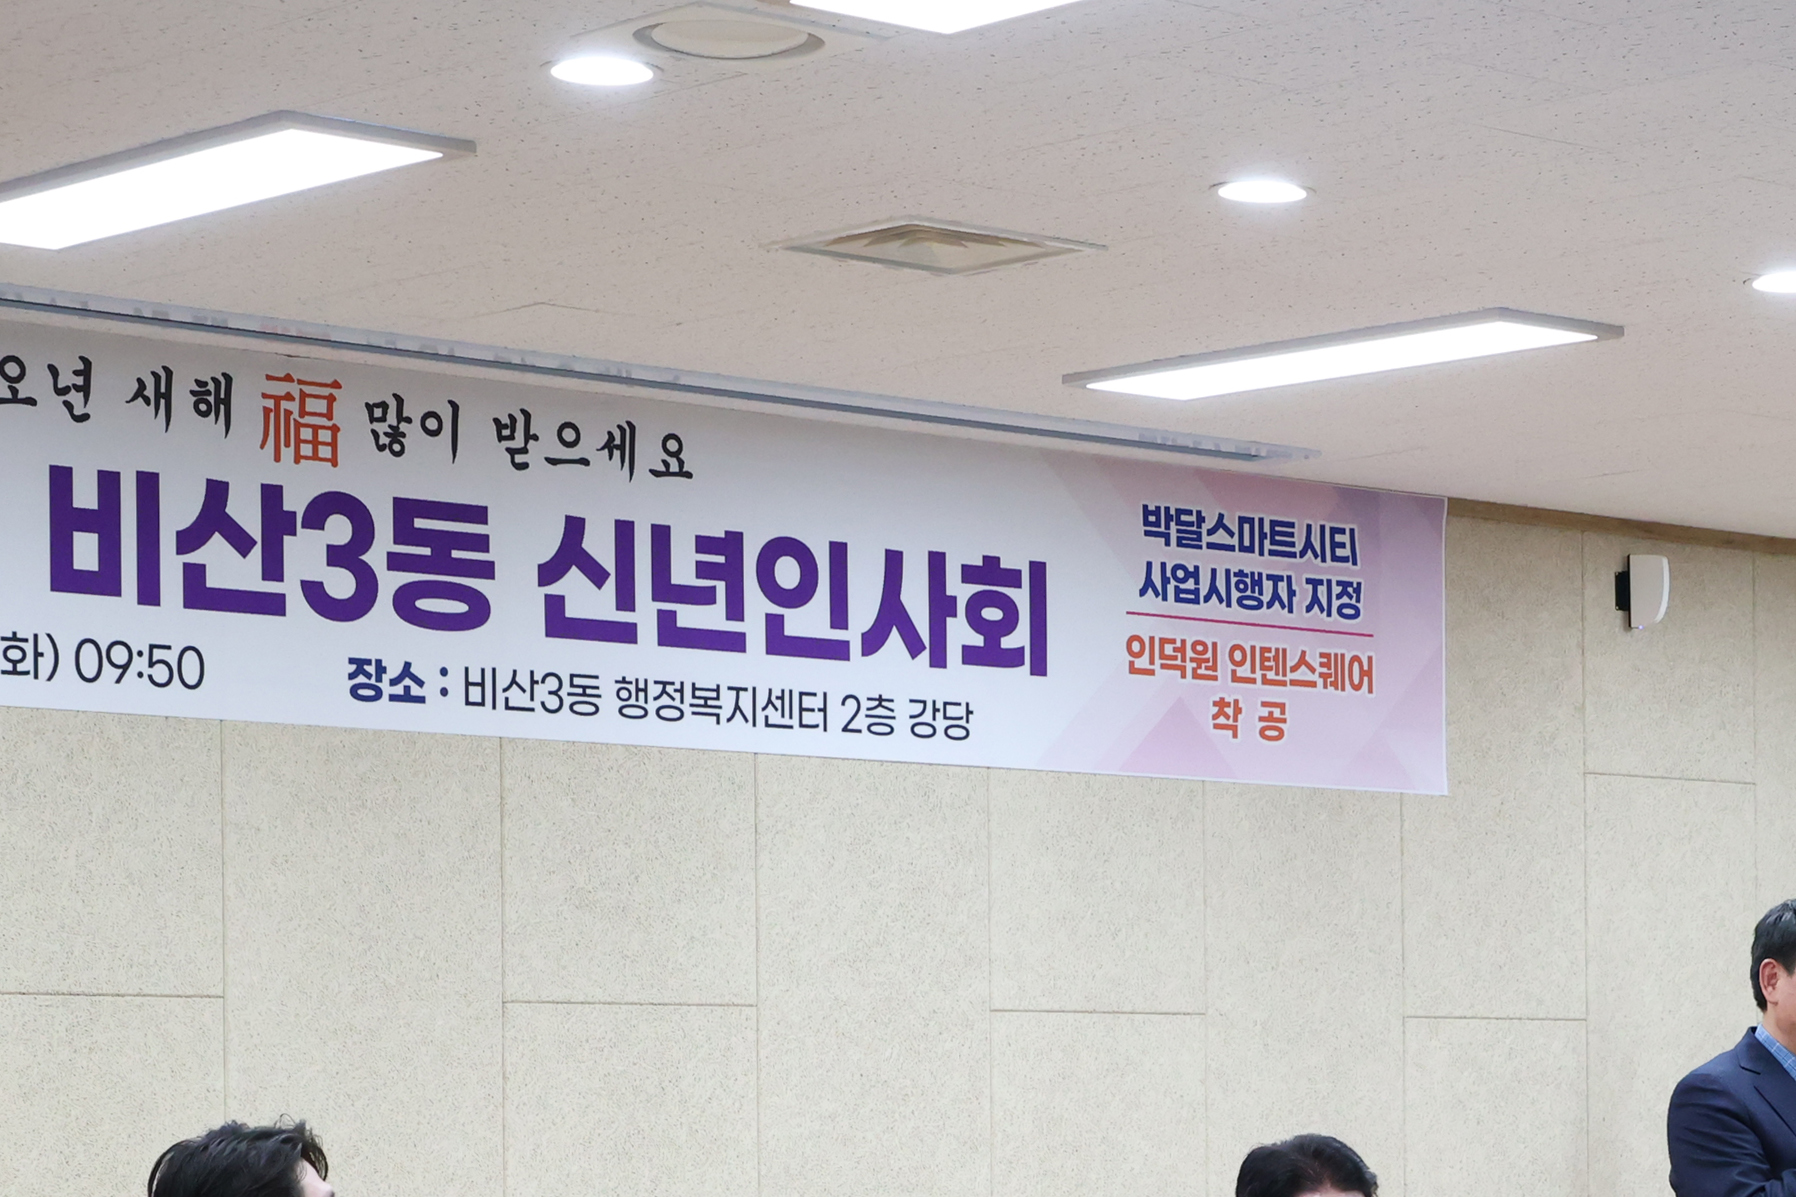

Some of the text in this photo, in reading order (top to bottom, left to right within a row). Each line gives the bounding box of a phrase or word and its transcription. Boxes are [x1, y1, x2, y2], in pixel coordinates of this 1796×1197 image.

[126, 366, 233, 438] 새해
[260, 372, 342, 468] 福
[365, 393, 459, 463] 많이
[493, 408, 694, 481] 받으세요
[1142, 504, 1358, 567] 박달스마트시티
[48, 464, 1048, 677] 비산3동 신년인사회
[1138, 561, 1362, 620] 사업시행자 지정
[74, 638, 205, 690] 09:50
[1126, 634, 1374, 694] 인덕원 인텐스퀘어
[464, 666, 602, 716] 비산3동
[614, 675, 828, 732] 행정복지센터
[840, 694, 897, 736] 2층
[908, 698, 974, 740] 강당
